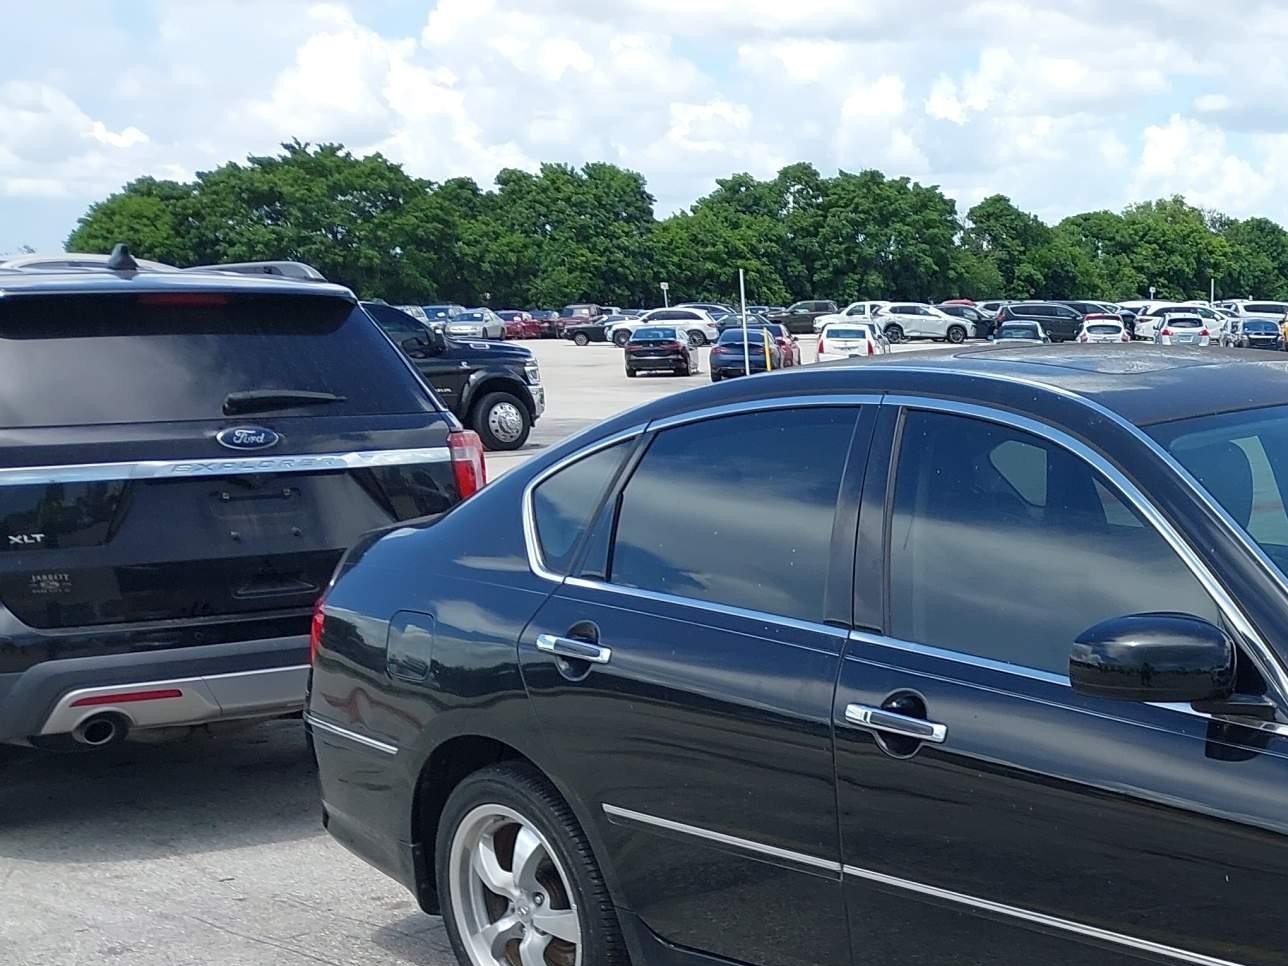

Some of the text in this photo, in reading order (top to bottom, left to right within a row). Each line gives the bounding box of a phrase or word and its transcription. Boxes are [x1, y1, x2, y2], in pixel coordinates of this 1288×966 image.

[232, 429, 265, 444] Ford
[171, 456, 339, 473] EXPLORER
[7, 533, 45, 545] XLT
